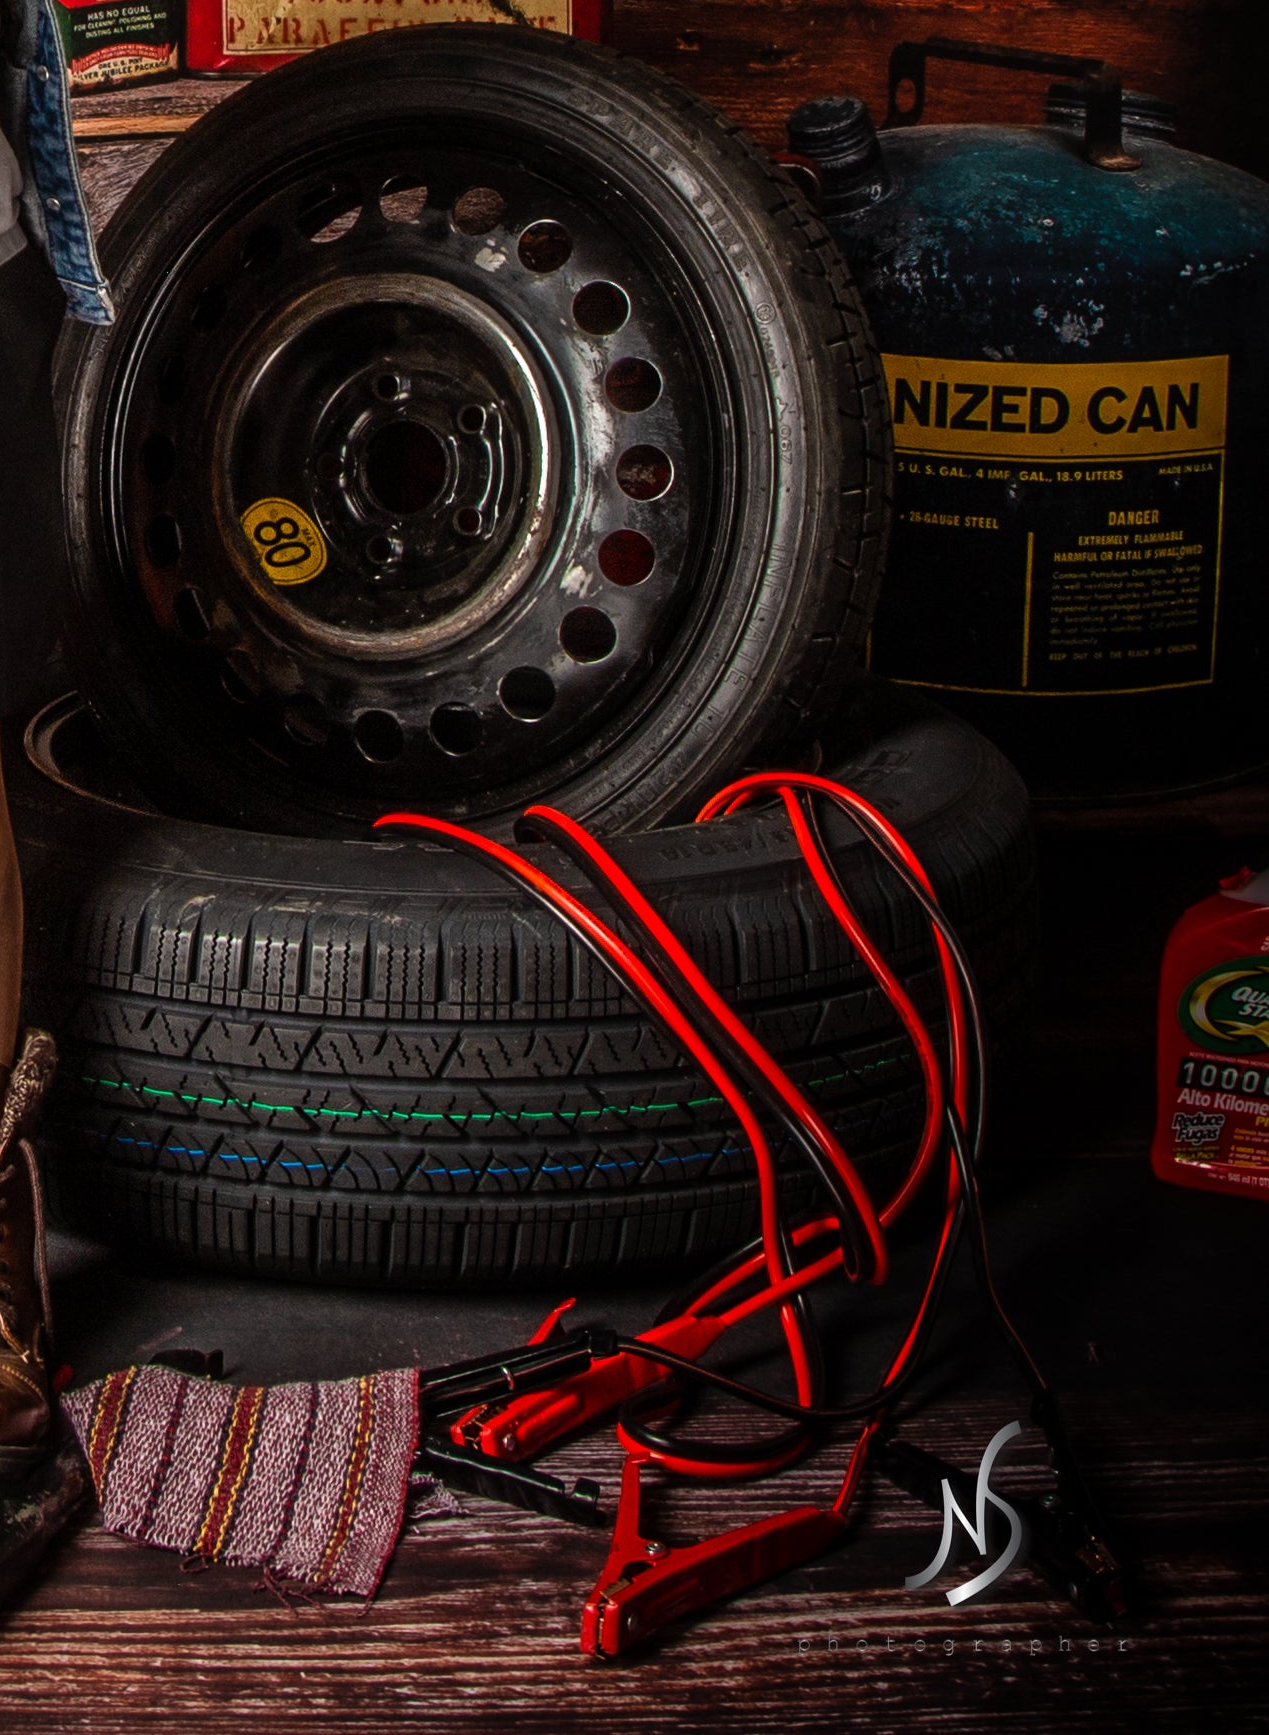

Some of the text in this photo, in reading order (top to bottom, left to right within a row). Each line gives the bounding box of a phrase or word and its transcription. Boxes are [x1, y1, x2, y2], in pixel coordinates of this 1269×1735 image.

[87, 5, 150, 21] HAS NO EQUAL
[893, 377, 1200, 436] NIZED CAN
[976, 468, 984, 479] 4
[1056, 470, 1082, 482] 18.9
[1086, 469, 1124, 481] LITERS
[964, 516, 999, 529] STEEL
[1108, 509, 1160, 527] DANGER
[254, 517, 311, 568] 80
[1078, 530, 1185, 547] EXTREMELY FLAMMABLE
[1053, 549, 1098, 563] HARMFUL
[1100, 550, 1113, 561] OR
[1115, 548, 1142, 561] FATAL
[1144, 547, 1153, 559] IF
[1177, 1088, 1211, 1107] Alto
[1173, 1112, 1226, 1130] Reduce
[1175, 1127, 1220, 1145] Fugas
